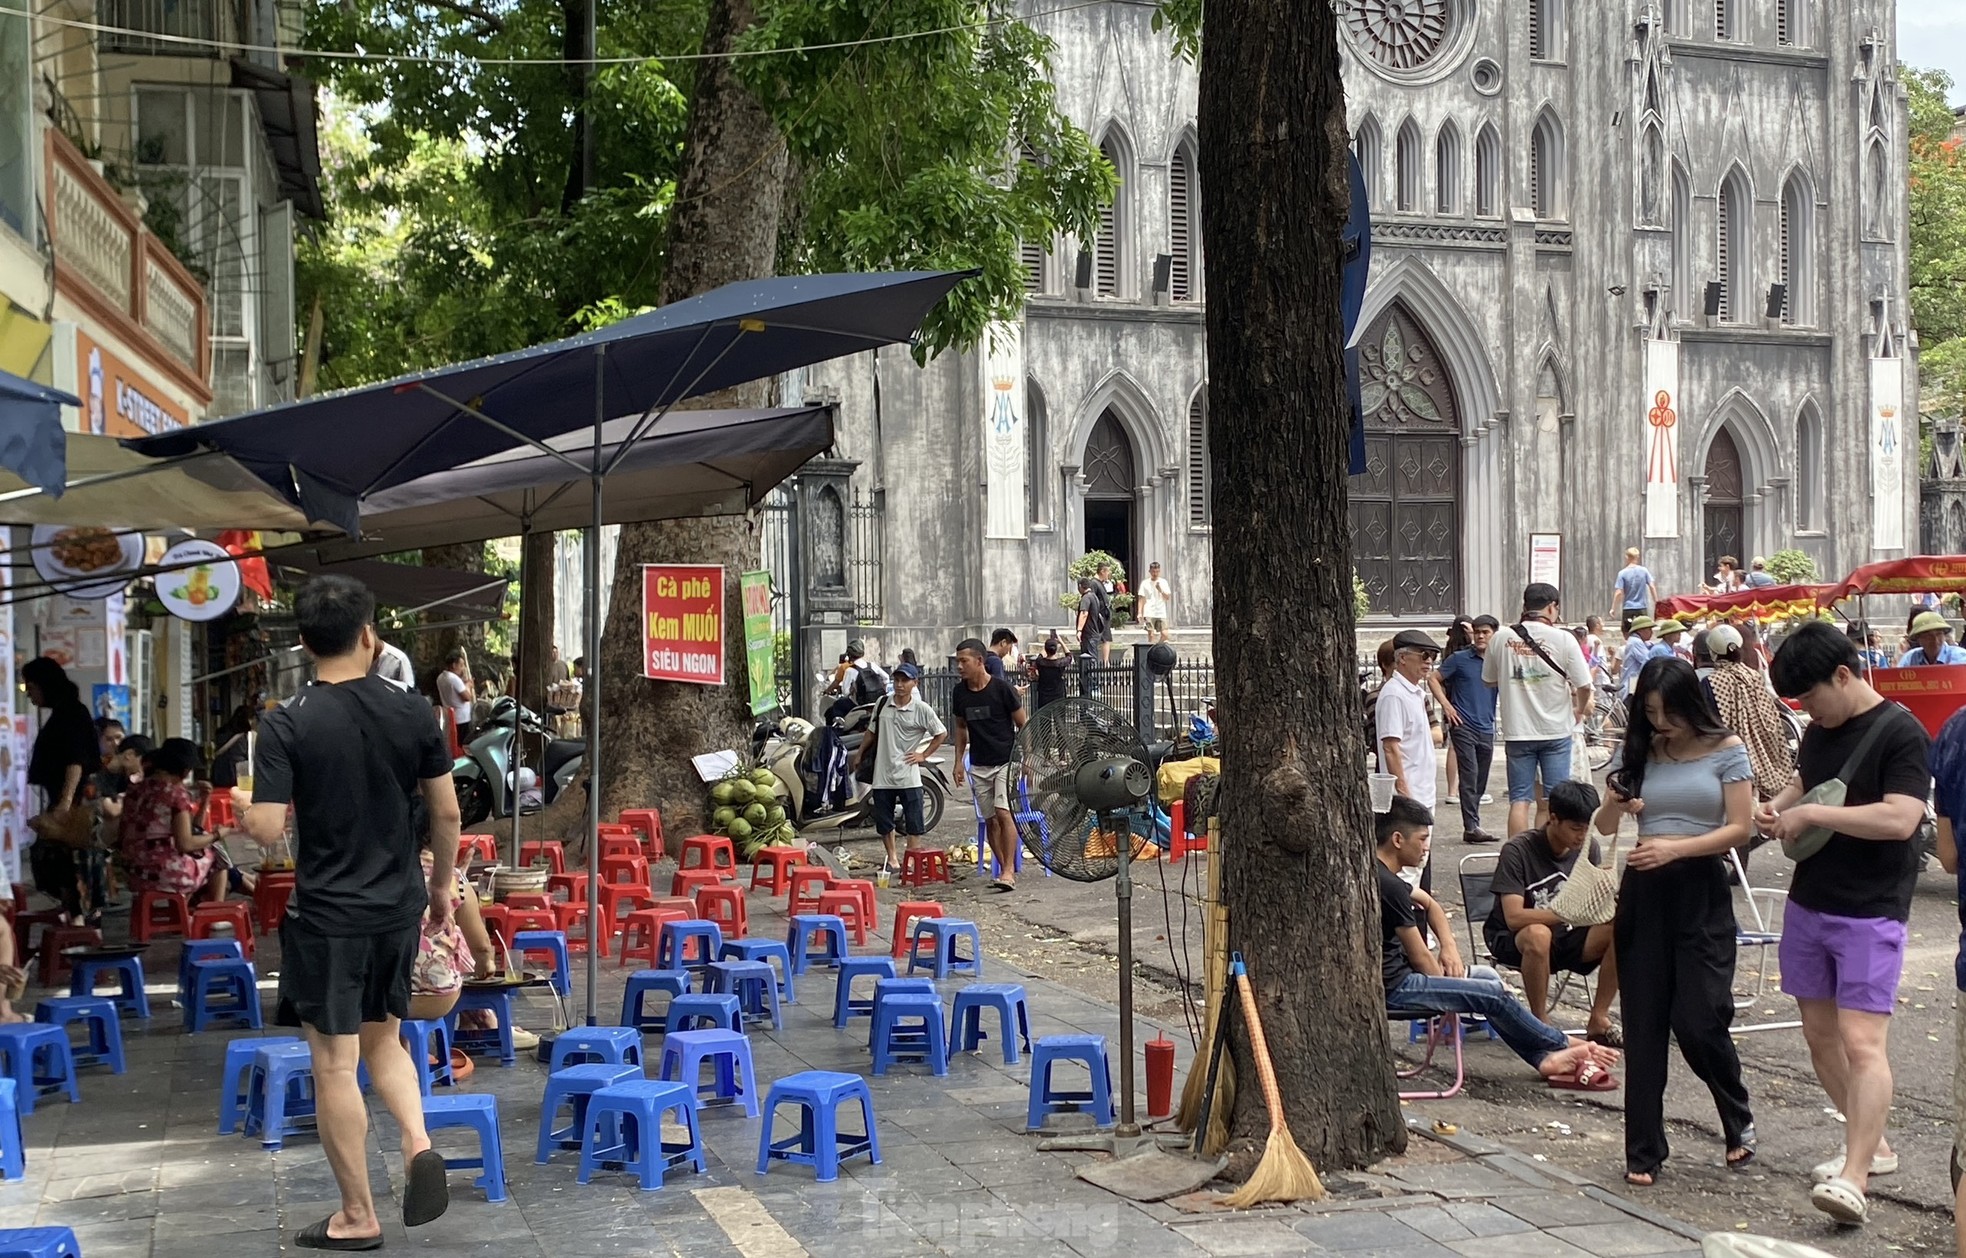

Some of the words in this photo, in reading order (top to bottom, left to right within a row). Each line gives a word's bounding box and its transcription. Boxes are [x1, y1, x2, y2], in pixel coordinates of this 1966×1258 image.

[657, 576, 678, 598] Cà
[682, 576, 711, 600] phê
[649, 611, 679, 640] Kem
[683, 603, 718, 642] MUỐI
[652, 647, 680, 671] SIÊU
[683, 652, 716, 674] NGON
